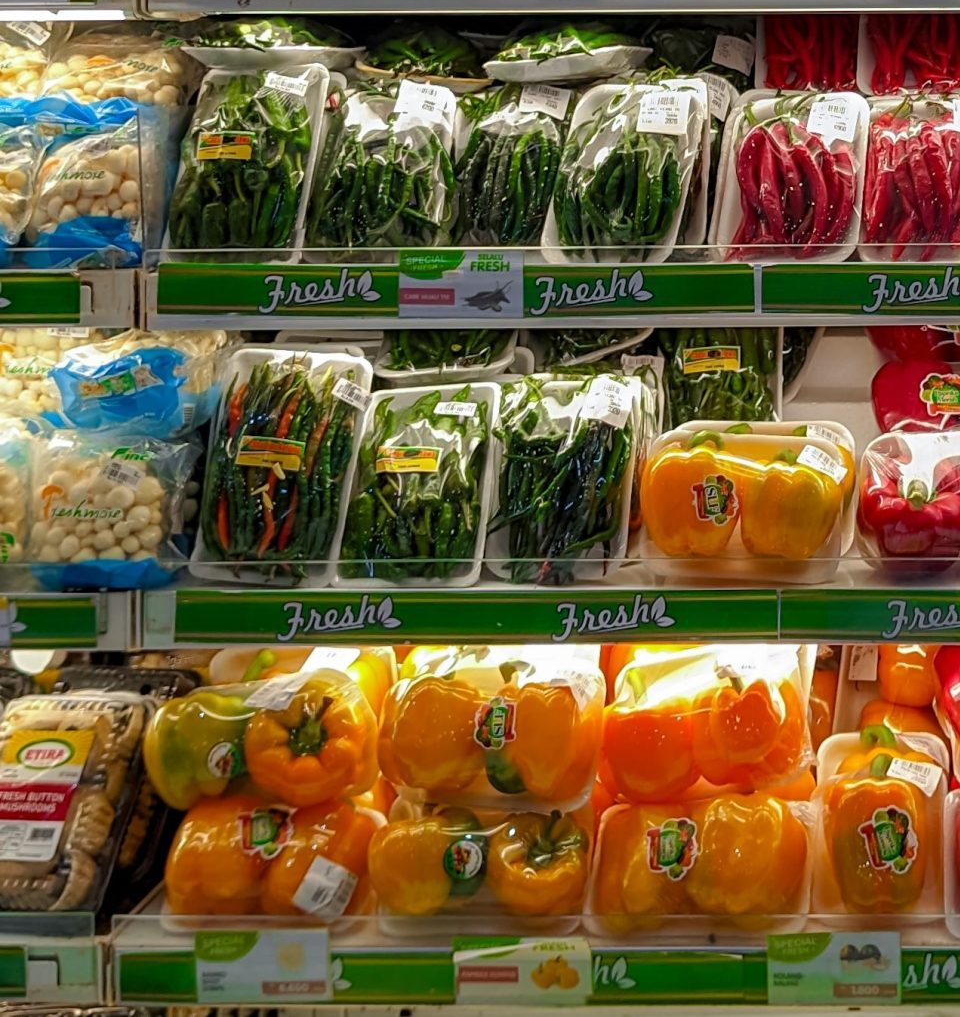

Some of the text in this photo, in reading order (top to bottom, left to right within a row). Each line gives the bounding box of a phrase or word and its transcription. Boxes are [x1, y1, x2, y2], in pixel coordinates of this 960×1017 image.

[406, 255, 444, 265] SPECIAL
[470, 262, 510, 271] FRESH
[259, 269, 359, 314] Fresh
[531, 270, 631, 316] Fresh
[862, 267, 959, 313] Fresh
[277, 594, 376, 641] Fresh
[551, 594, 650, 641] Fresh
[24, 747, 65, 761] ETIRA
[27, 791, 65, 802] BUTTON
